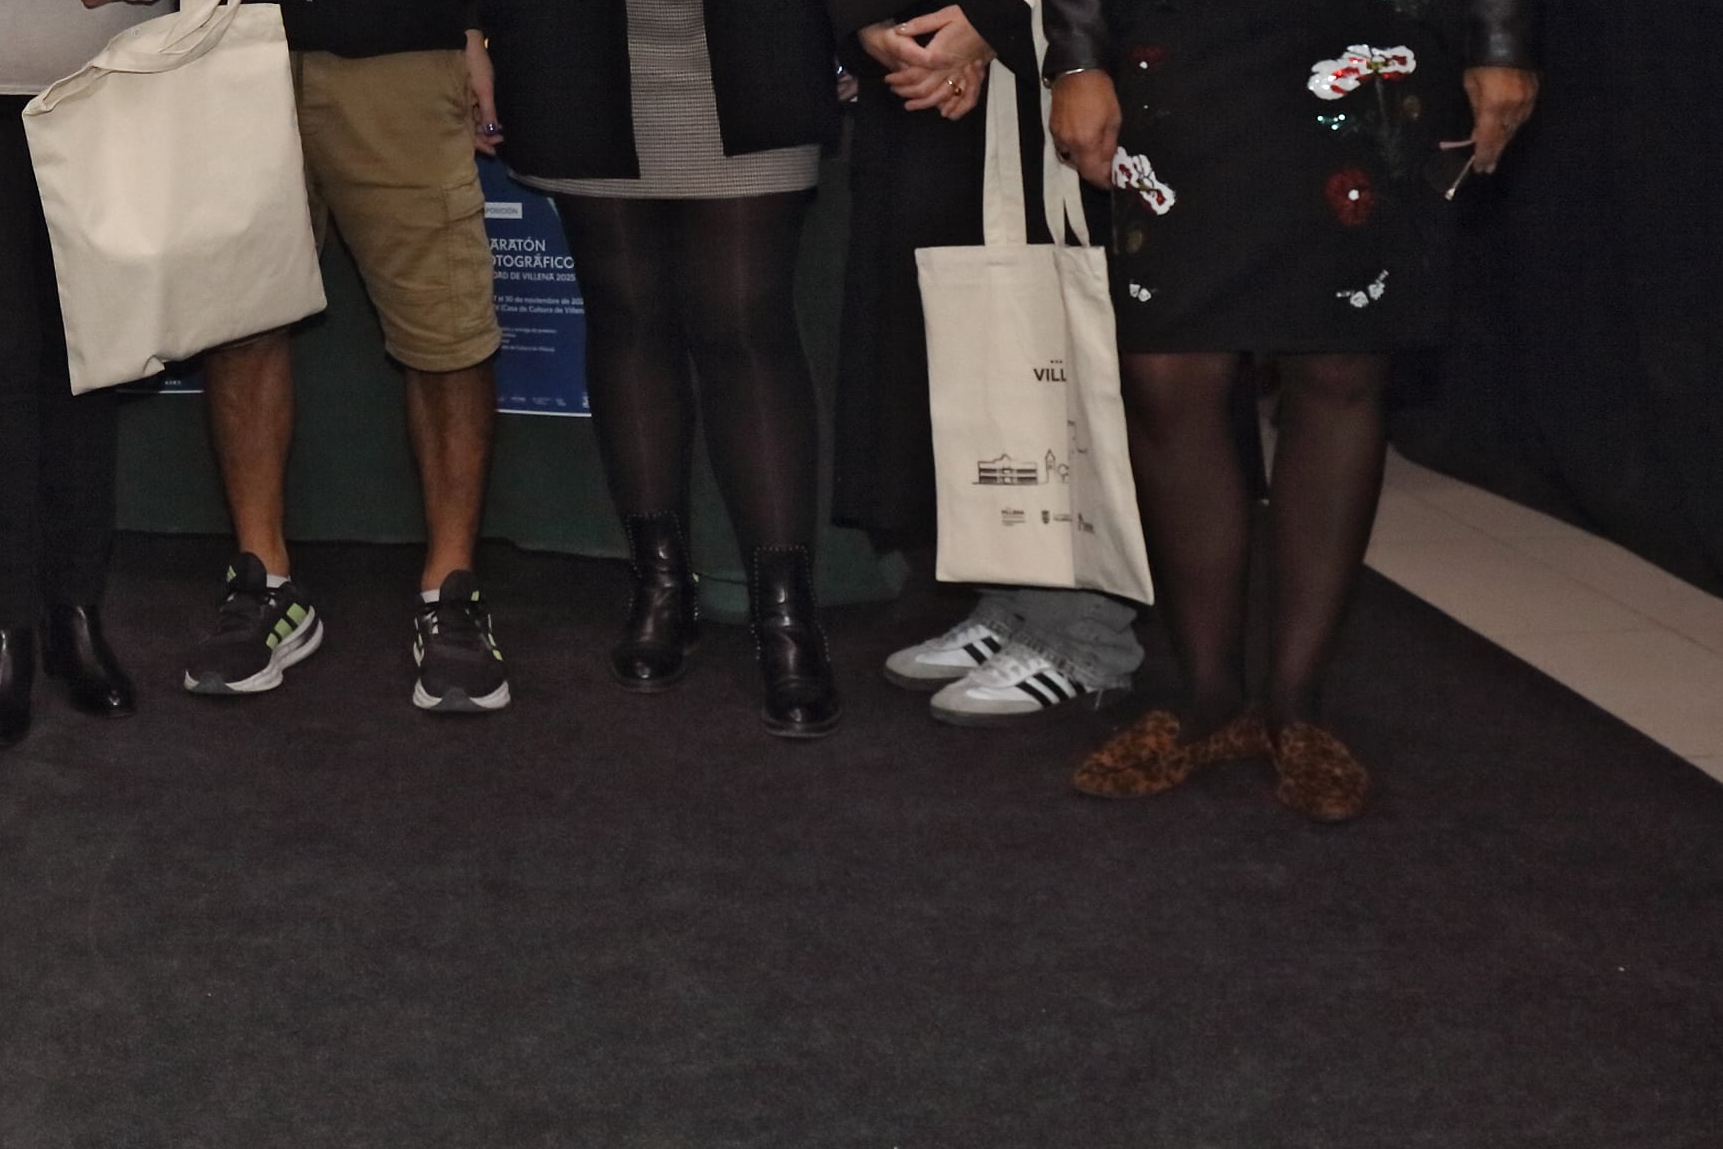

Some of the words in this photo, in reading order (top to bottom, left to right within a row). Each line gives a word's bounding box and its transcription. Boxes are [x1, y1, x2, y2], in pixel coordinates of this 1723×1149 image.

[489, 236, 546, 252] ARATÓN
[493, 253, 575, 269] TOGRÁFICO
[522, 272, 555, 281] VILLENA
